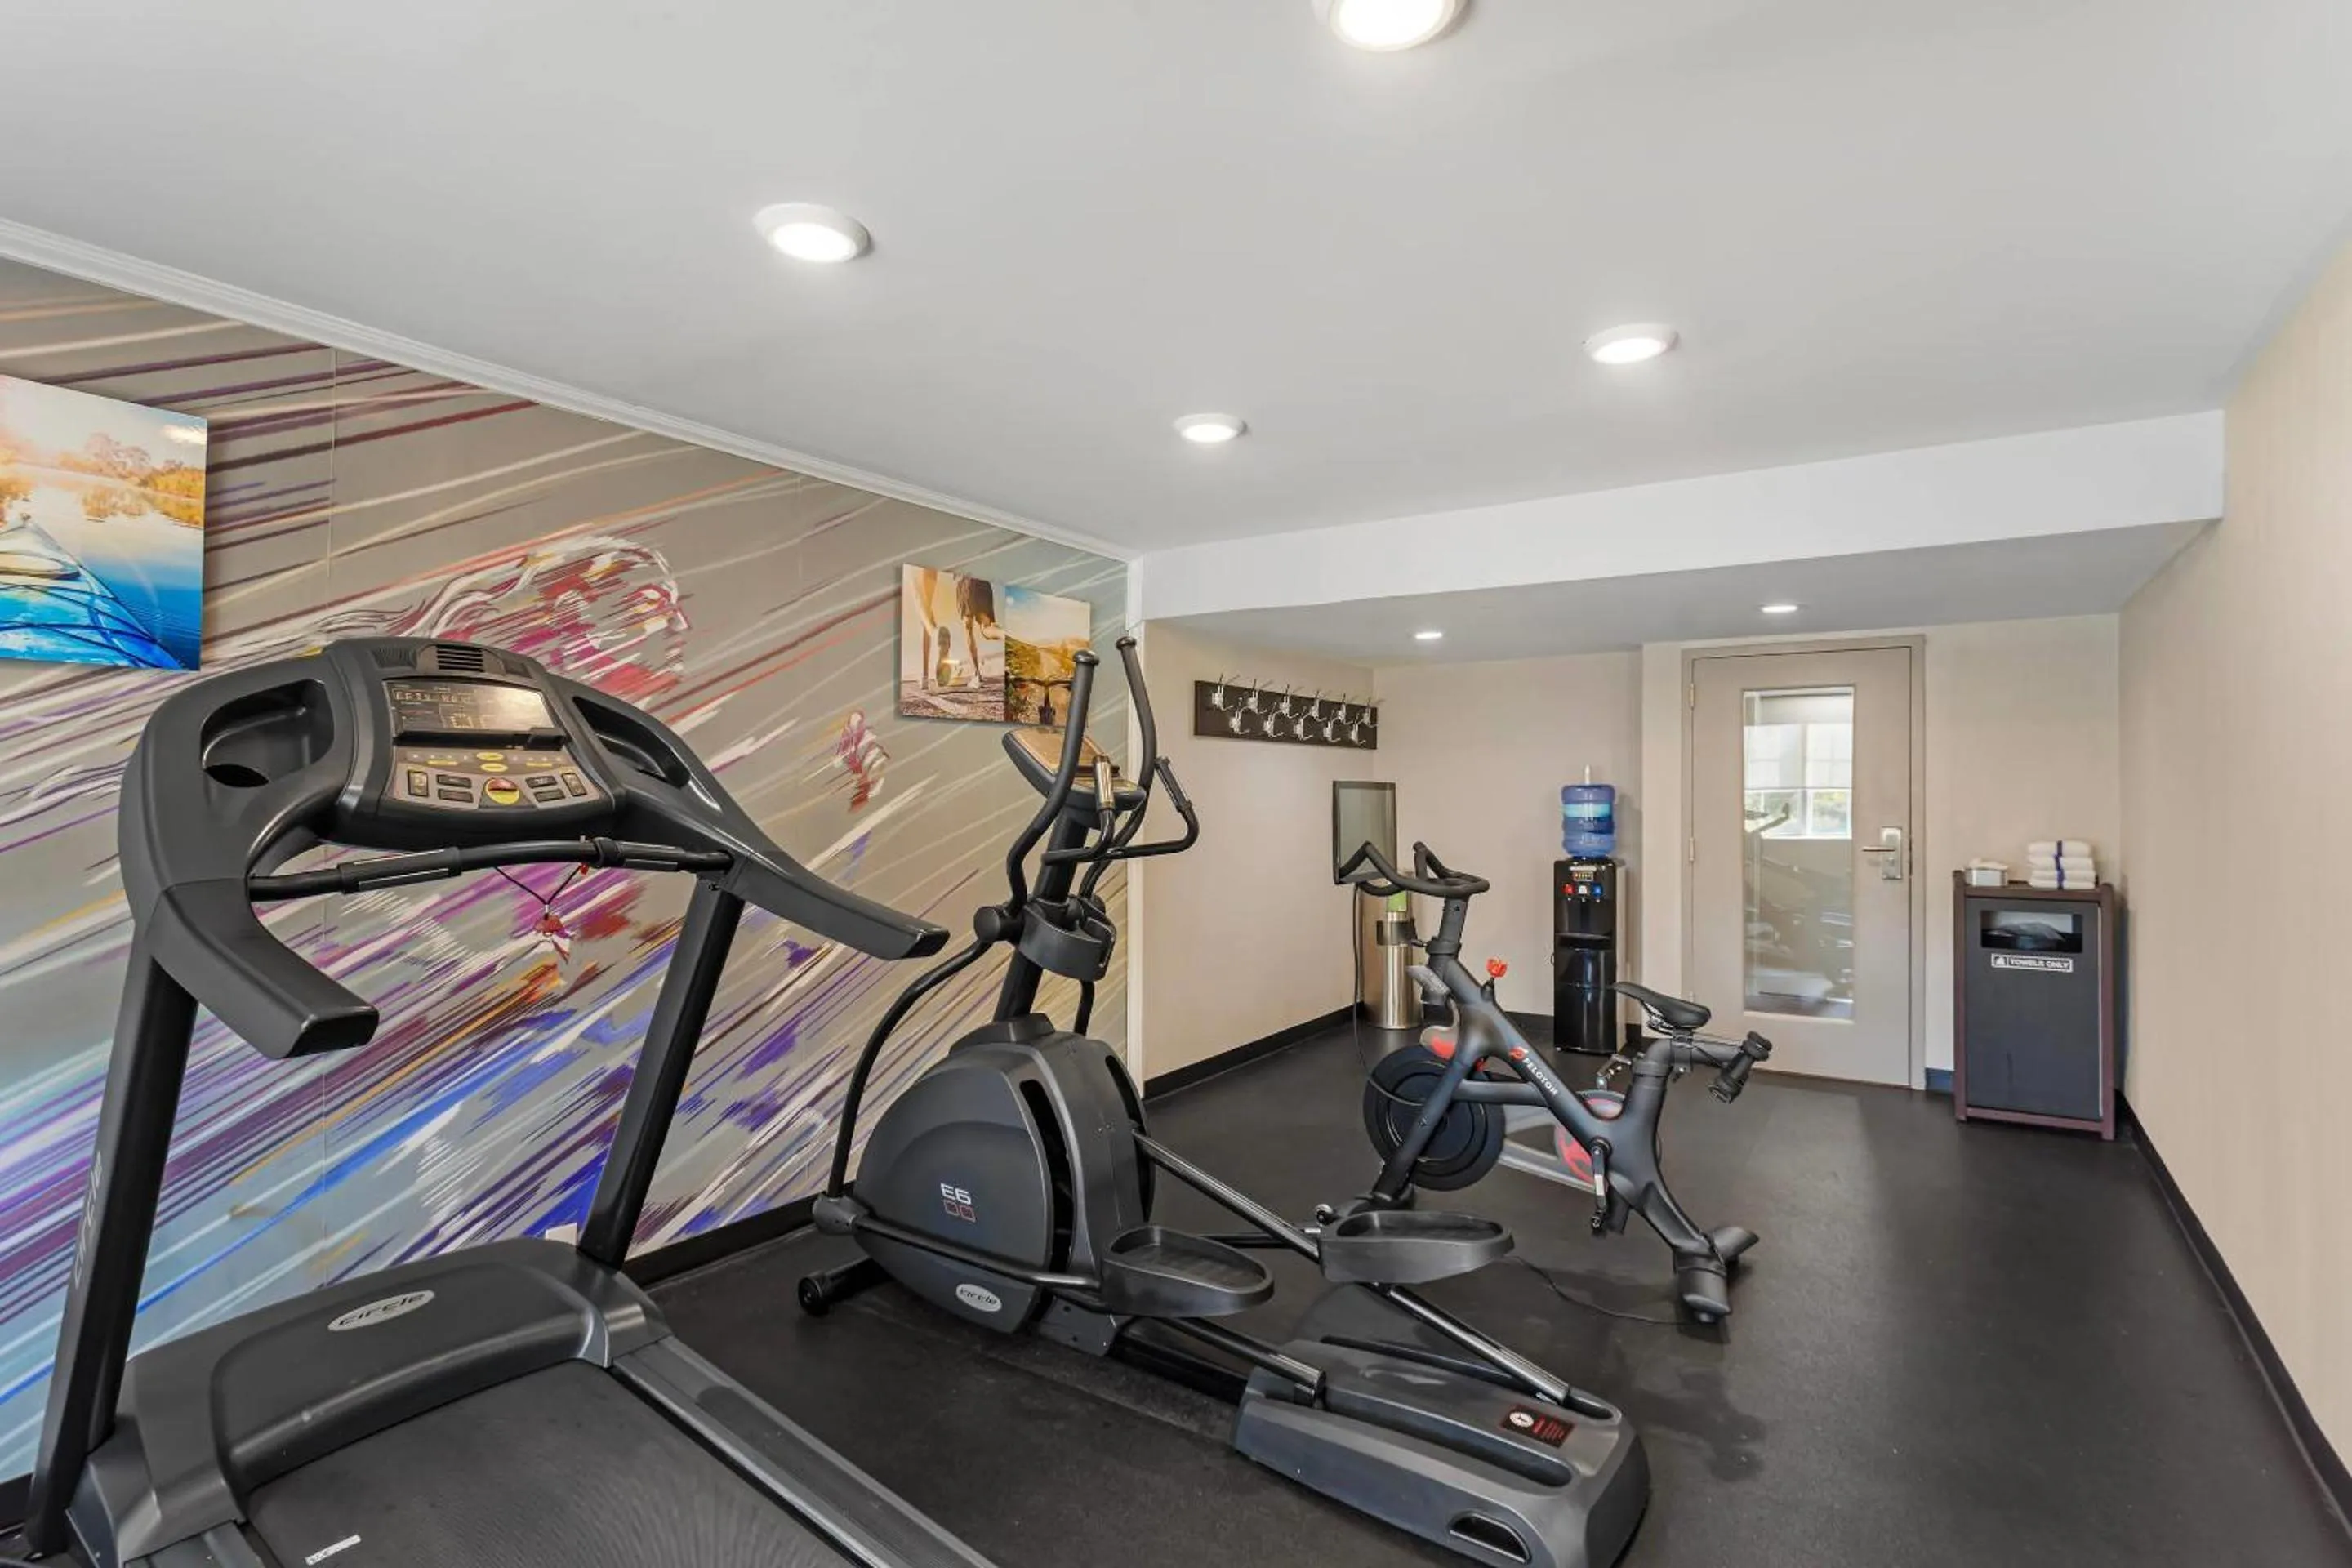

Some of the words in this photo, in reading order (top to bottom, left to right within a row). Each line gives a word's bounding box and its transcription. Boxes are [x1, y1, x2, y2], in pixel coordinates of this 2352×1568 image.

[2046, 960, 2069, 969] ONLY
[1522, 1058, 1558, 1095] PELOTON
[940, 1183, 972, 1205] E6
[958, 1286, 997, 1304] circle
[339, 1293, 425, 1325] circle
